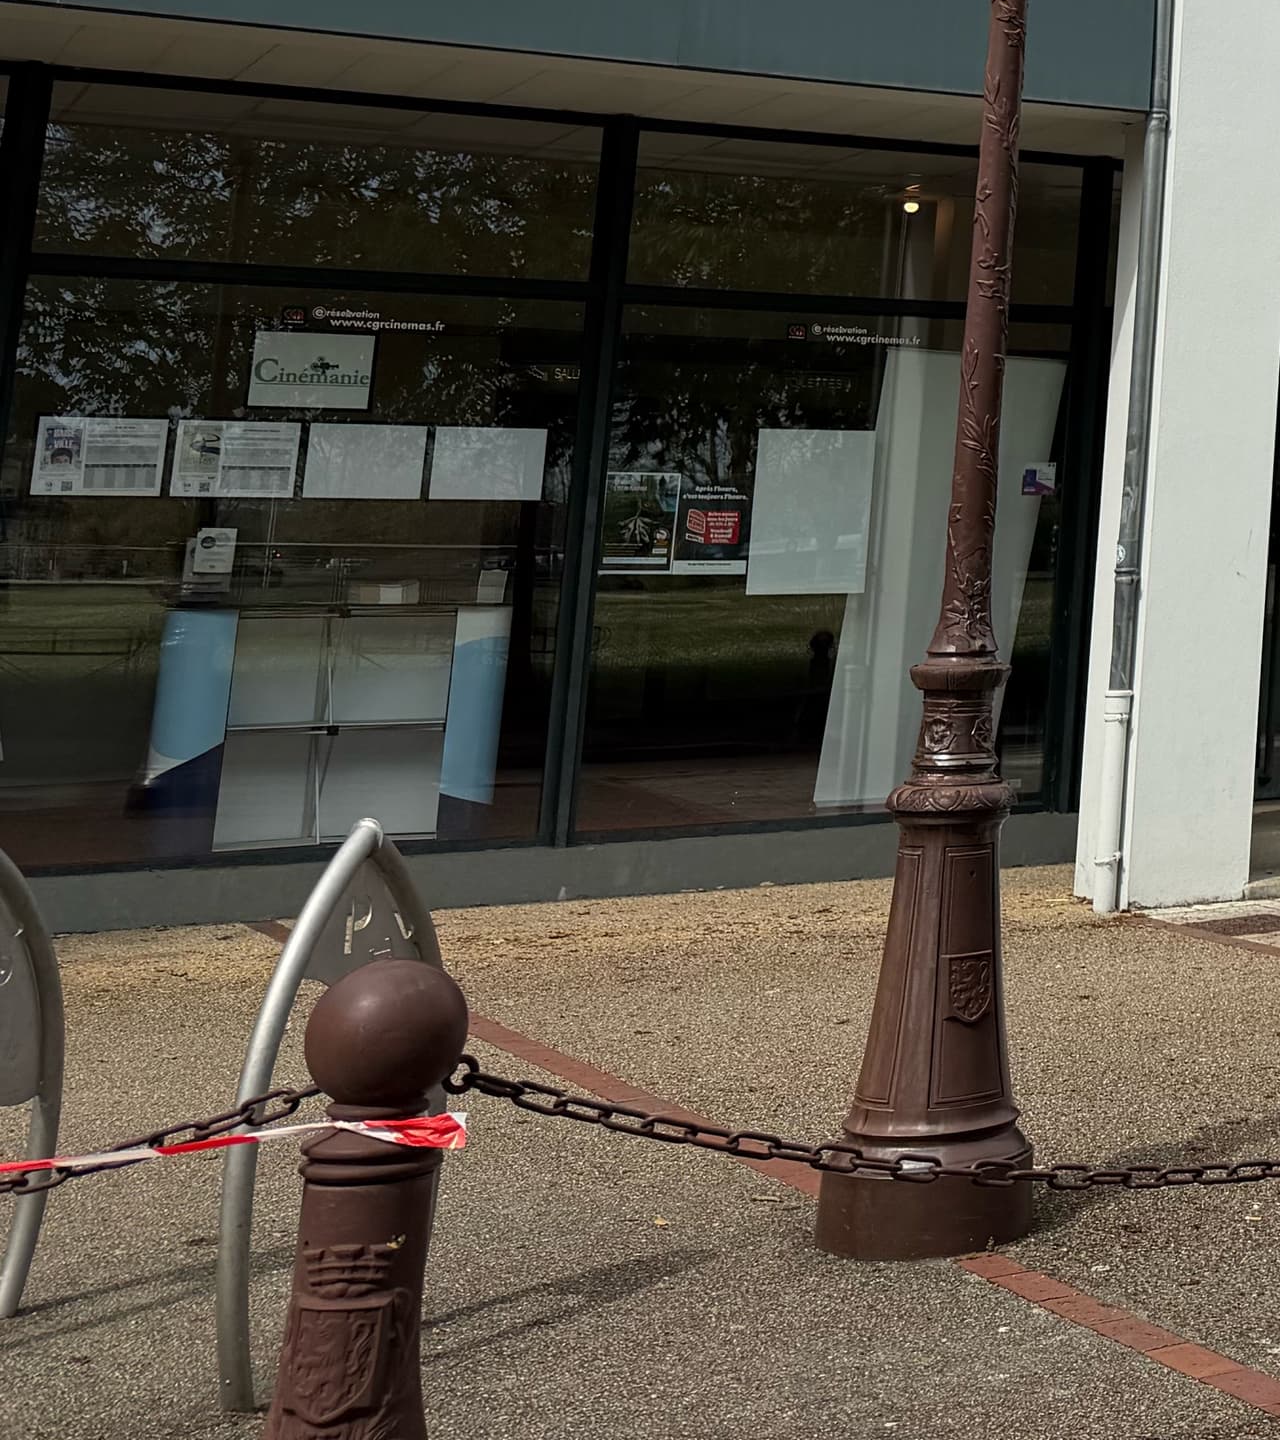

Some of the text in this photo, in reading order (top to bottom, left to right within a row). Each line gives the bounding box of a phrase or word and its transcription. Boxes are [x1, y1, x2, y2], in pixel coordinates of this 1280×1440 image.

[330, 318, 446, 331] www.cgrcinemas.fr
[826, 334, 921, 345] www.cgrcinemas.fr
[254, 358, 370, 385] Cinémanie
